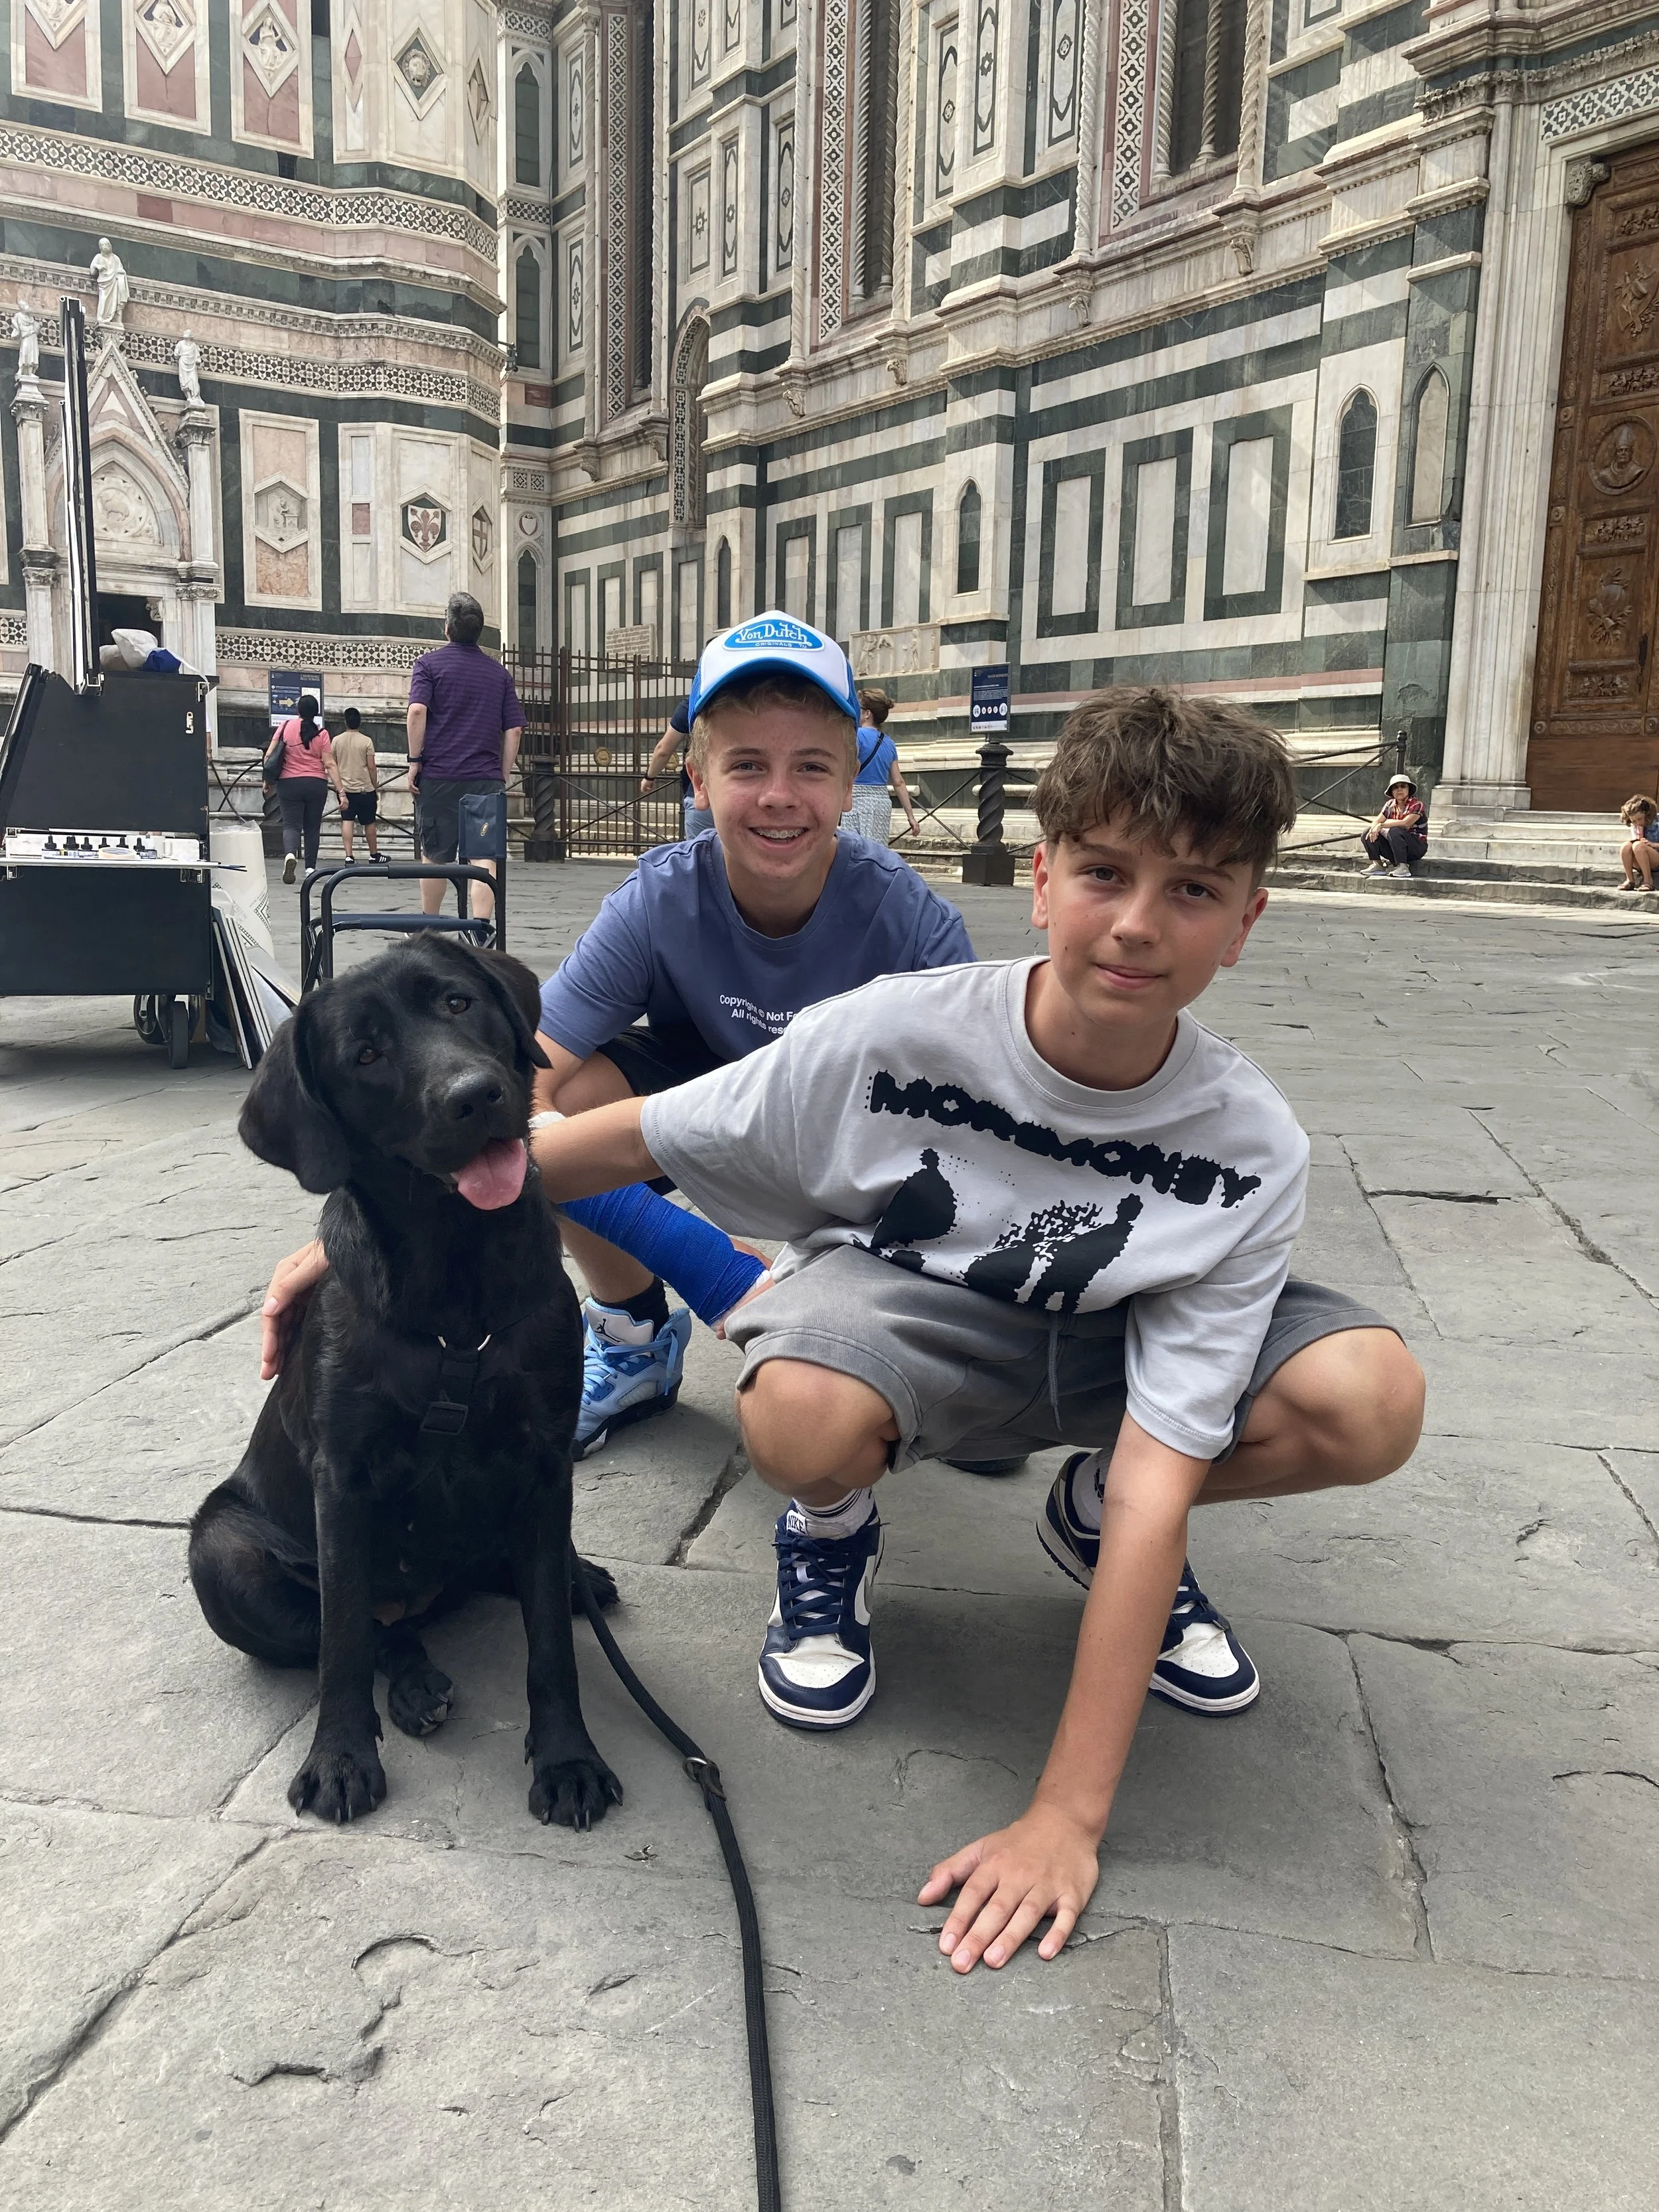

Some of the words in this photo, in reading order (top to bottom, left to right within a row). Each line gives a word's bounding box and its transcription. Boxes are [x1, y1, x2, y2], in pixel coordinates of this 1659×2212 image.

[736, 628, 764, 642] Von
[763, 622, 810, 644] Dutch
[719, 994, 758, 1014] Copyright
[766, 1011, 784, 1021] Not
[731, 1008, 745, 1019] All
[746, 1013, 766, 1030] rights
[788, 1514, 806, 1534] NIKE
